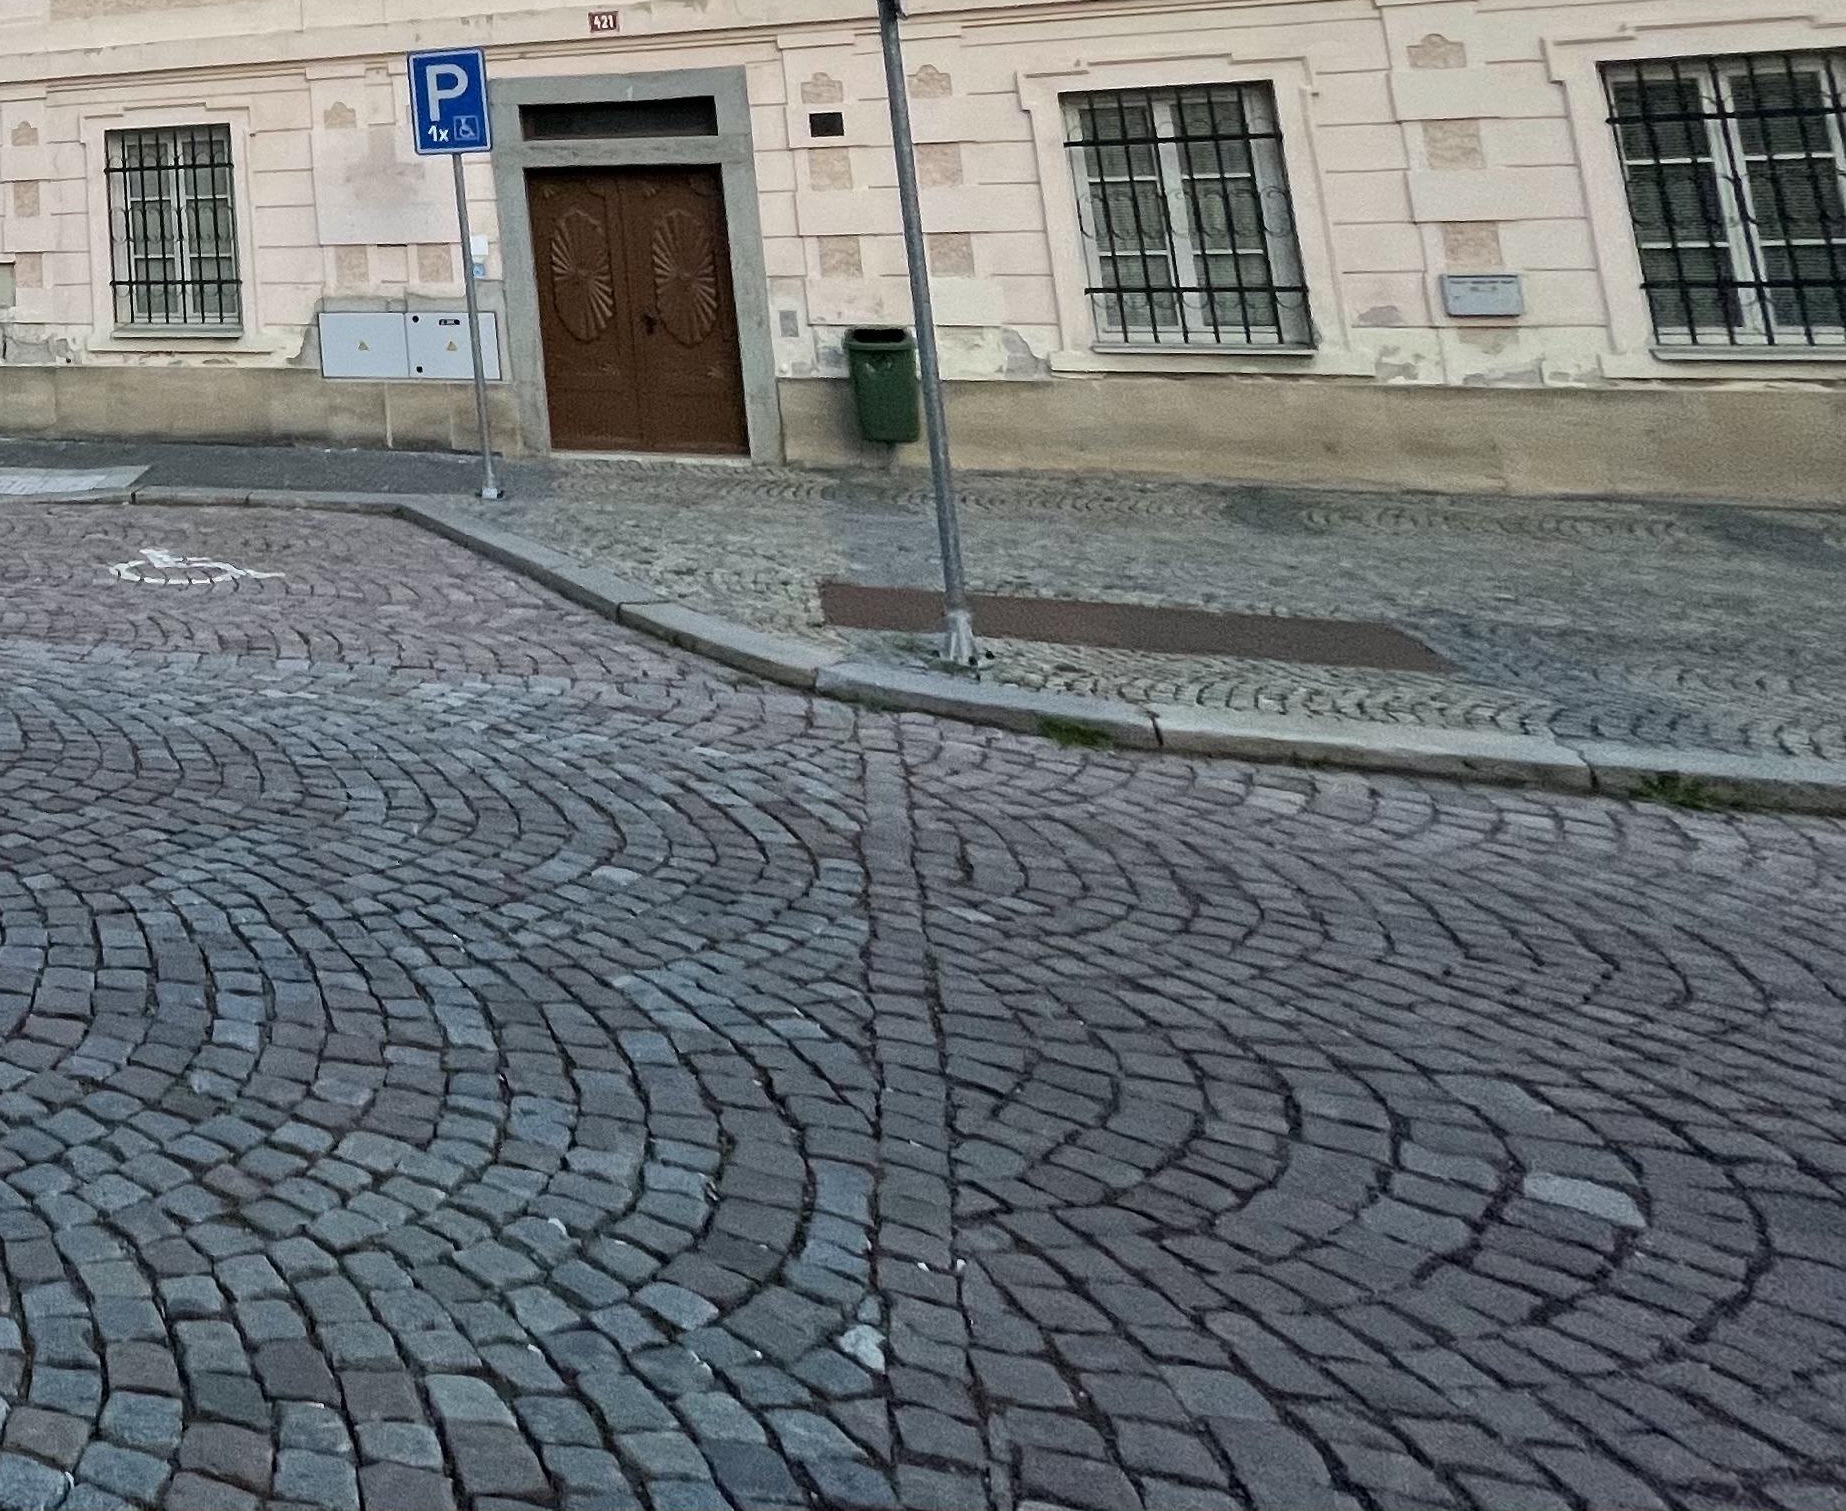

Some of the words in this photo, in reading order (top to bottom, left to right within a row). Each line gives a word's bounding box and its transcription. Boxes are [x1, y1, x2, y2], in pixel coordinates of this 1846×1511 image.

[594, 14, 614, 29] 421
[425, 63, 469, 122] P
[427, 124, 450, 142] 1x
